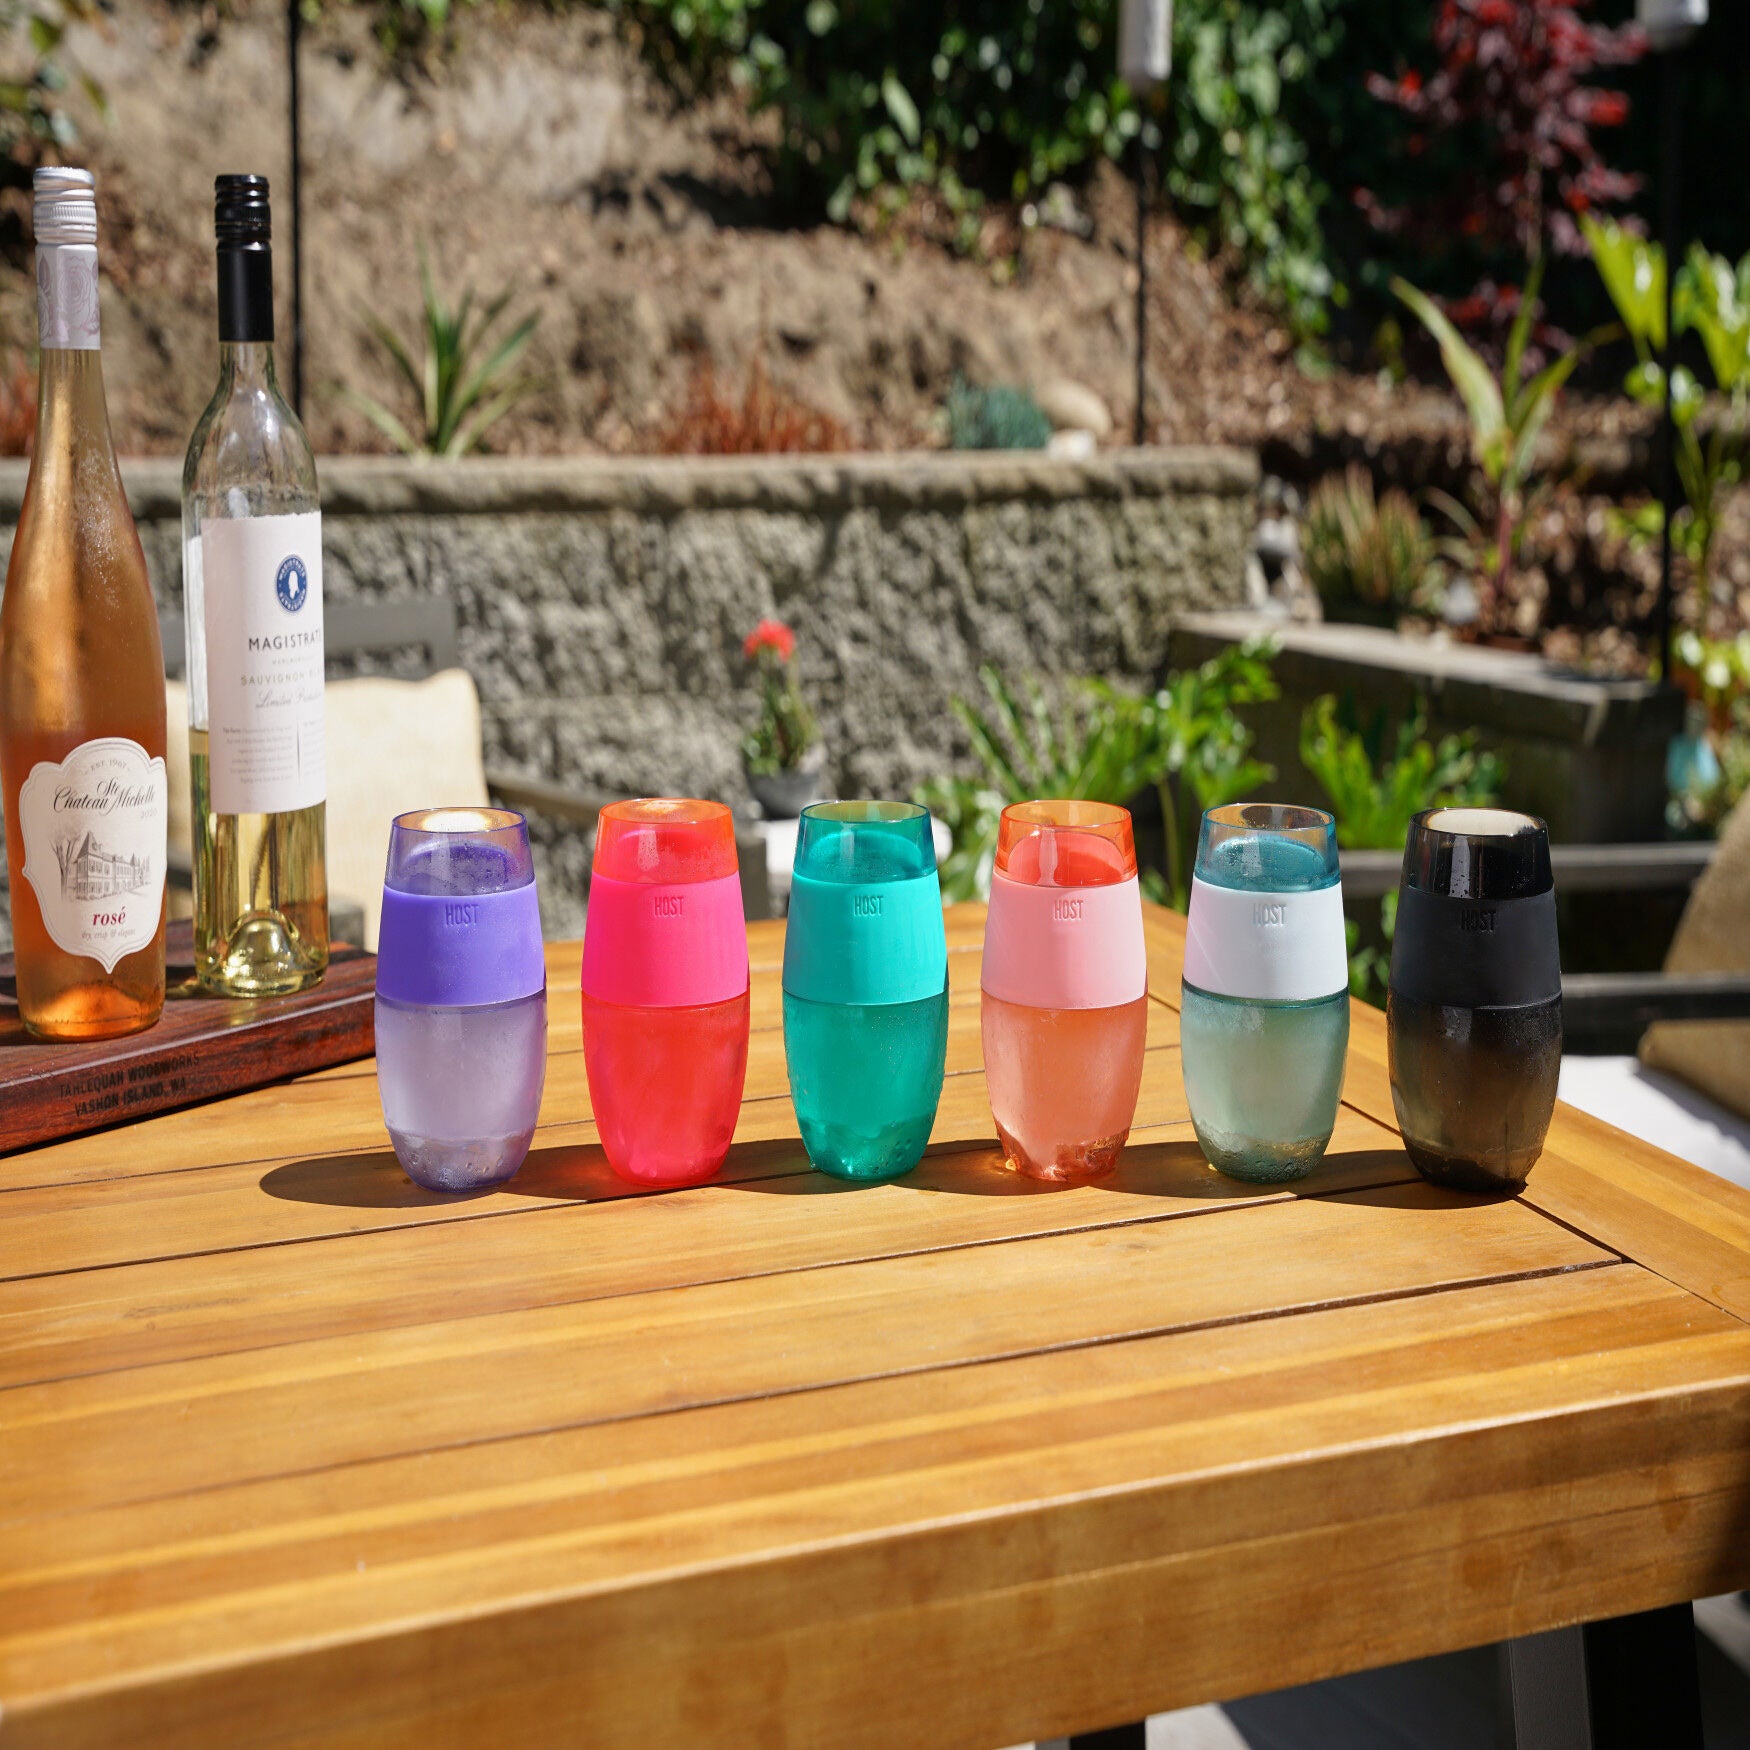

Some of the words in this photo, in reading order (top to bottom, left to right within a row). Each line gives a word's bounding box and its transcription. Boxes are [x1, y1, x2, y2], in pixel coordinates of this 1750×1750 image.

[240, 672, 304, 687] SAUVIGNON
[53, 784, 109, 813] Chateau
[92, 905, 126, 926] rosé
[445, 903, 479, 926] HOST
[653, 895, 685, 916] HOST
[853, 895, 884, 917] HOST
[1053, 899, 1085, 921] HOST
[1252, 903, 1288, 927] HOST
[1460, 910, 1497, 932] HOST
[59, 1071, 125, 1099] TAHLEQUAH
[127, 1053, 201, 1083] WOODWORKS
[74, 1094, 120, 1117] VASHON
[170, 1077, 187, 1095] WA
